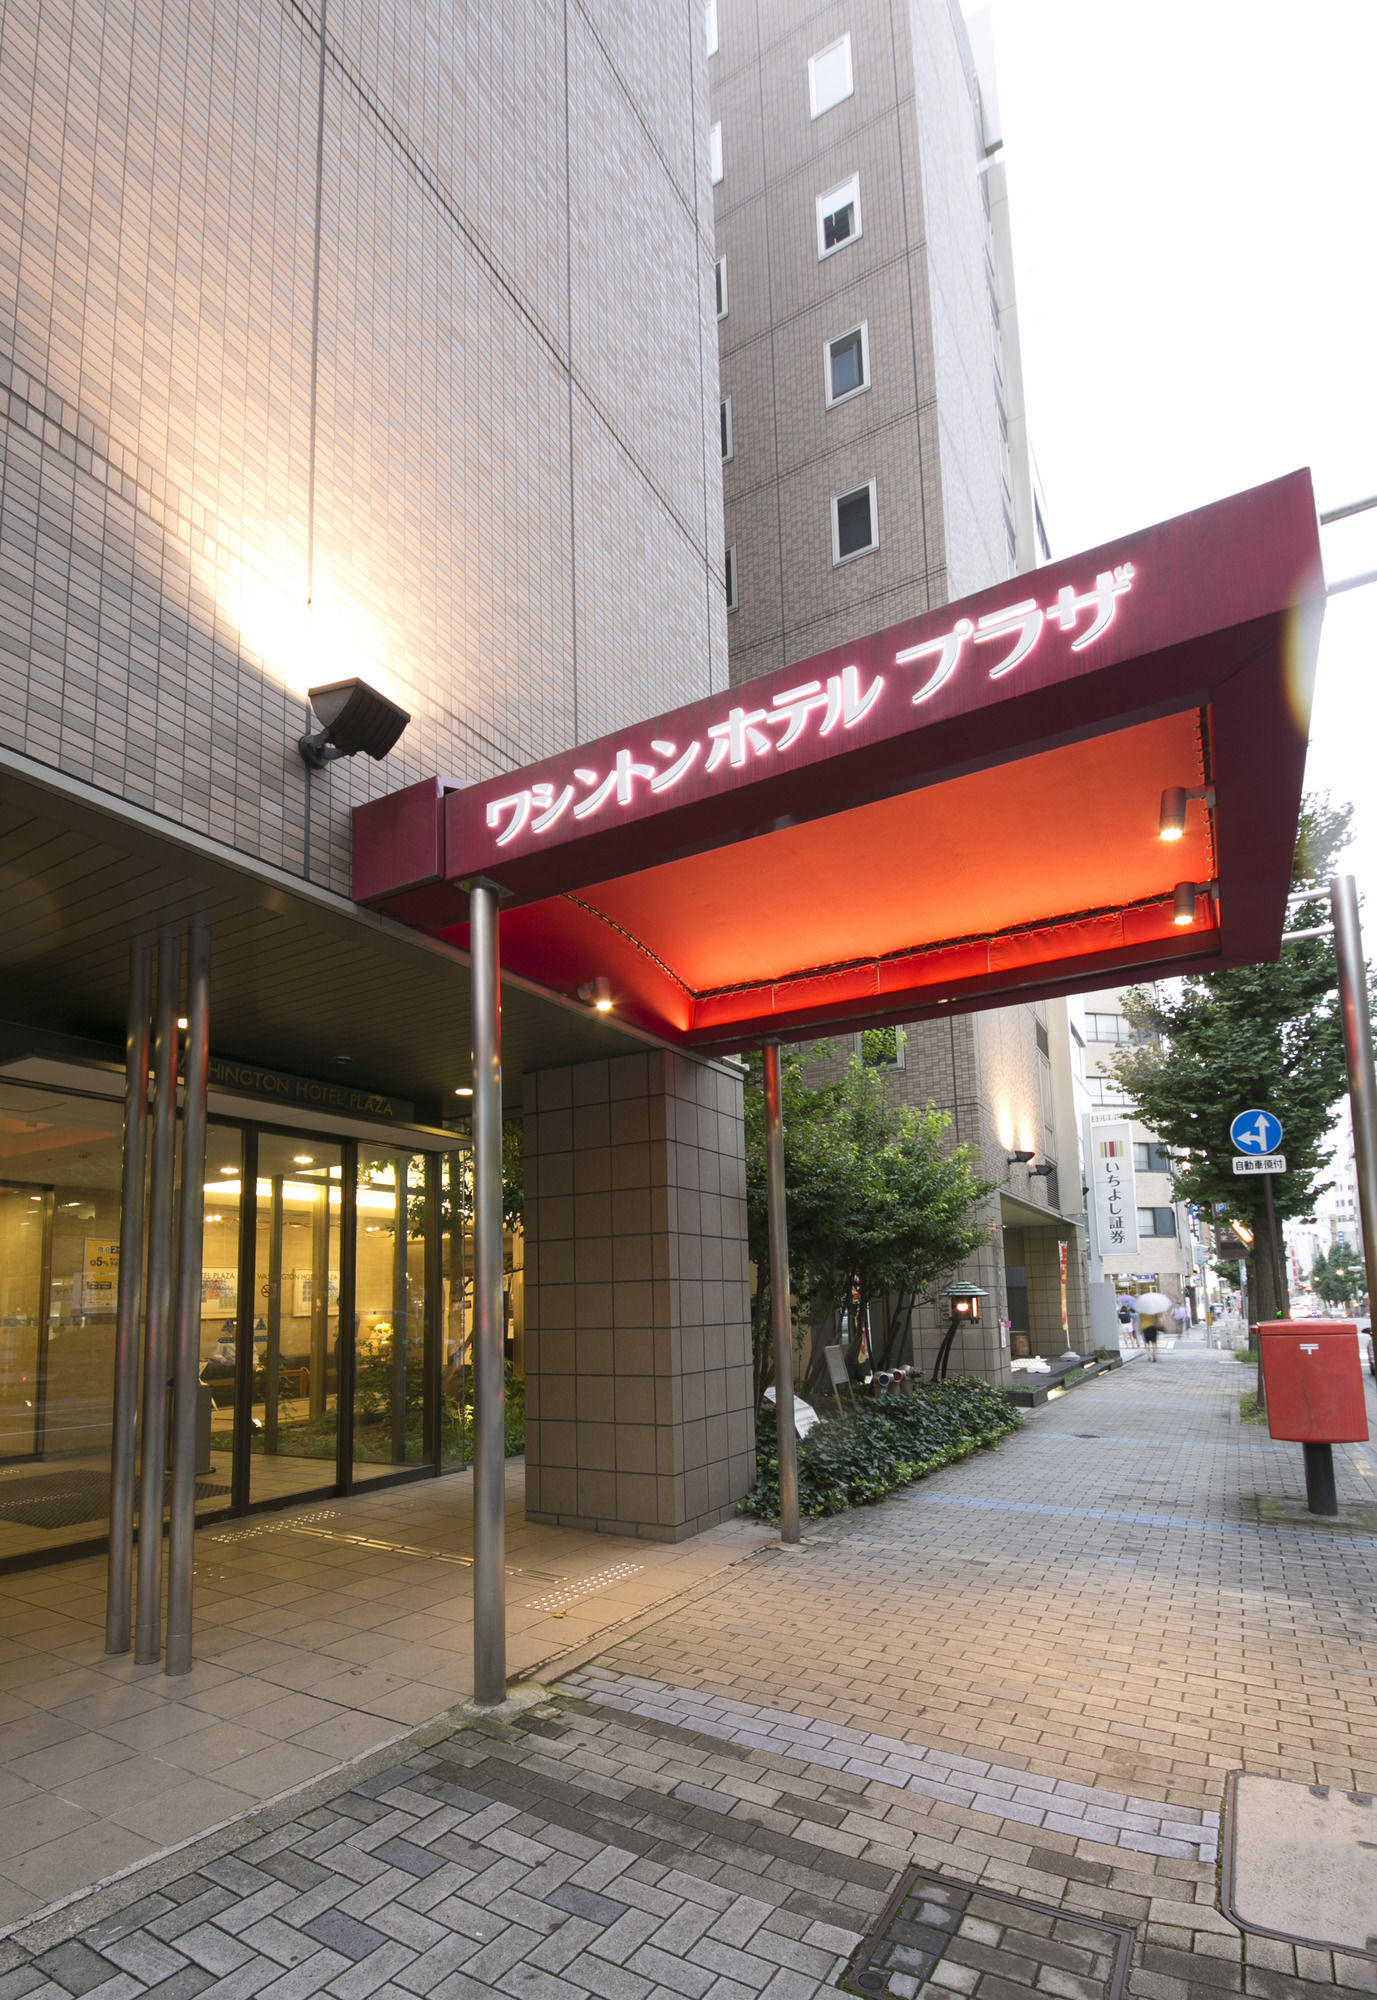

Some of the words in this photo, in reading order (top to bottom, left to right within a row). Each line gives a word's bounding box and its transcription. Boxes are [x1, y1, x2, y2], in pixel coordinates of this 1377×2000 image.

[896, 562, 1134, 705] プラザ
[178, 1056, 289, 1093] HINGTON
[296, 1080, 344, 1107] HOTEL
[350, 1093, 394, 1116] PLAZA
[1106, 1162, 1126, 1244] いちよし証券
